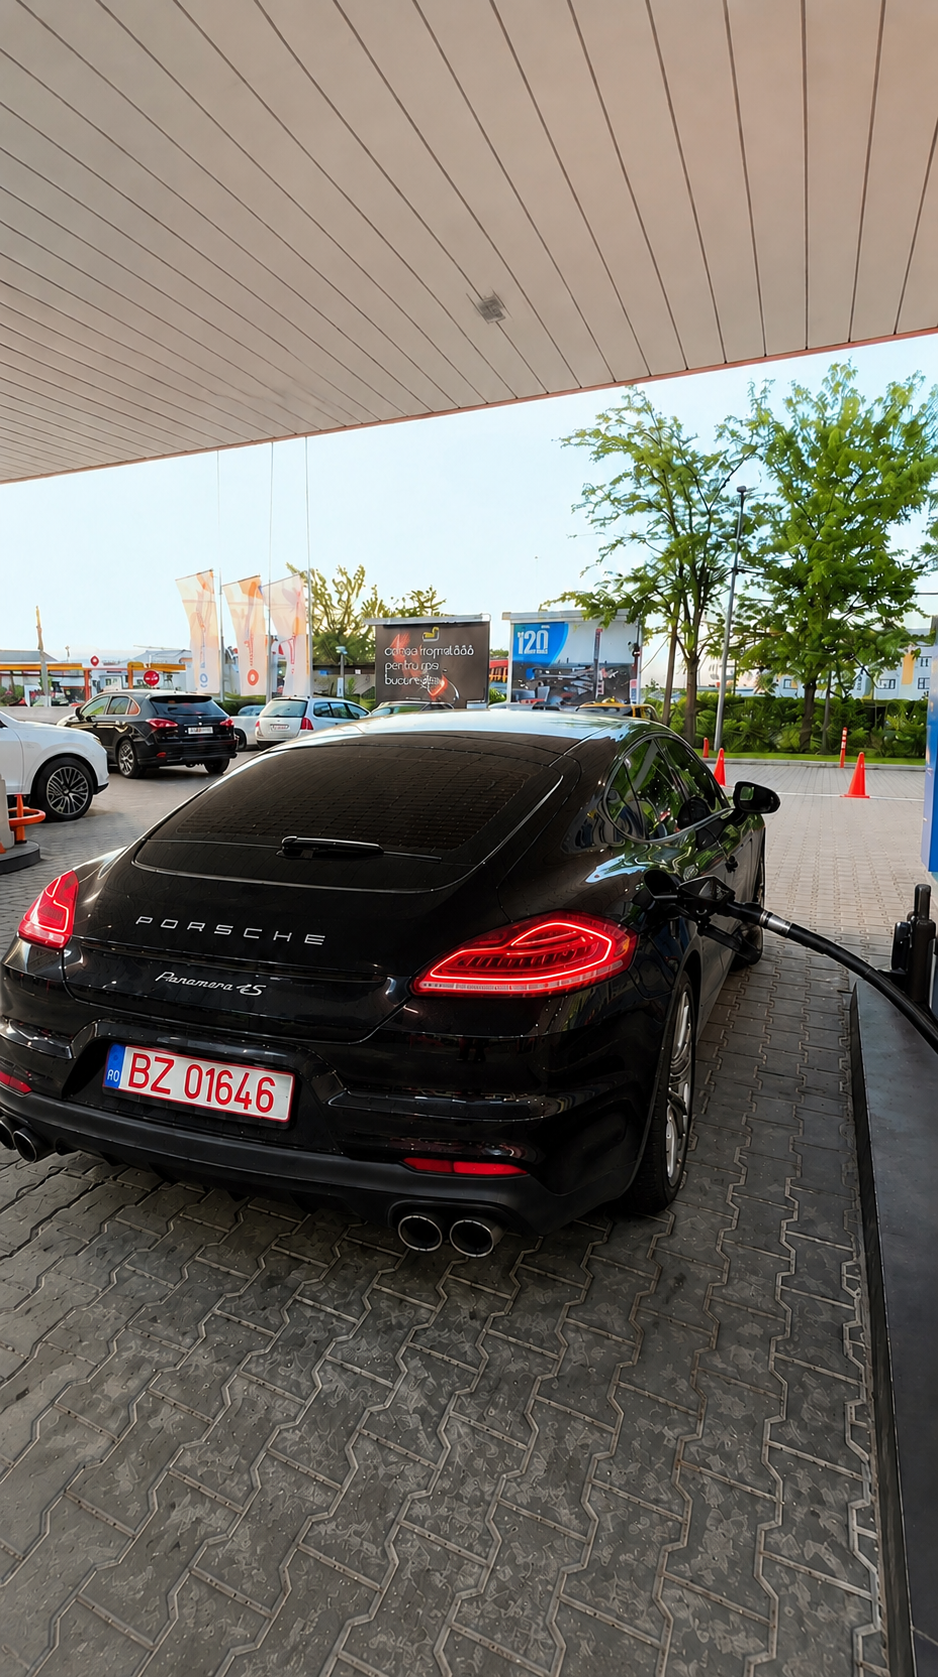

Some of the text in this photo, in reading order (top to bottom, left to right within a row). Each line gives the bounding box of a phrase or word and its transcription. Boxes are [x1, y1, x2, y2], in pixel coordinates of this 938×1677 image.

[135, 916, 326, 946] PORSCHE
[155, 971, 266, 996] Panamera 4S
[107, 1069, 120, 1083] RO
[128, 1053, 276, 1114] BZ 01646
